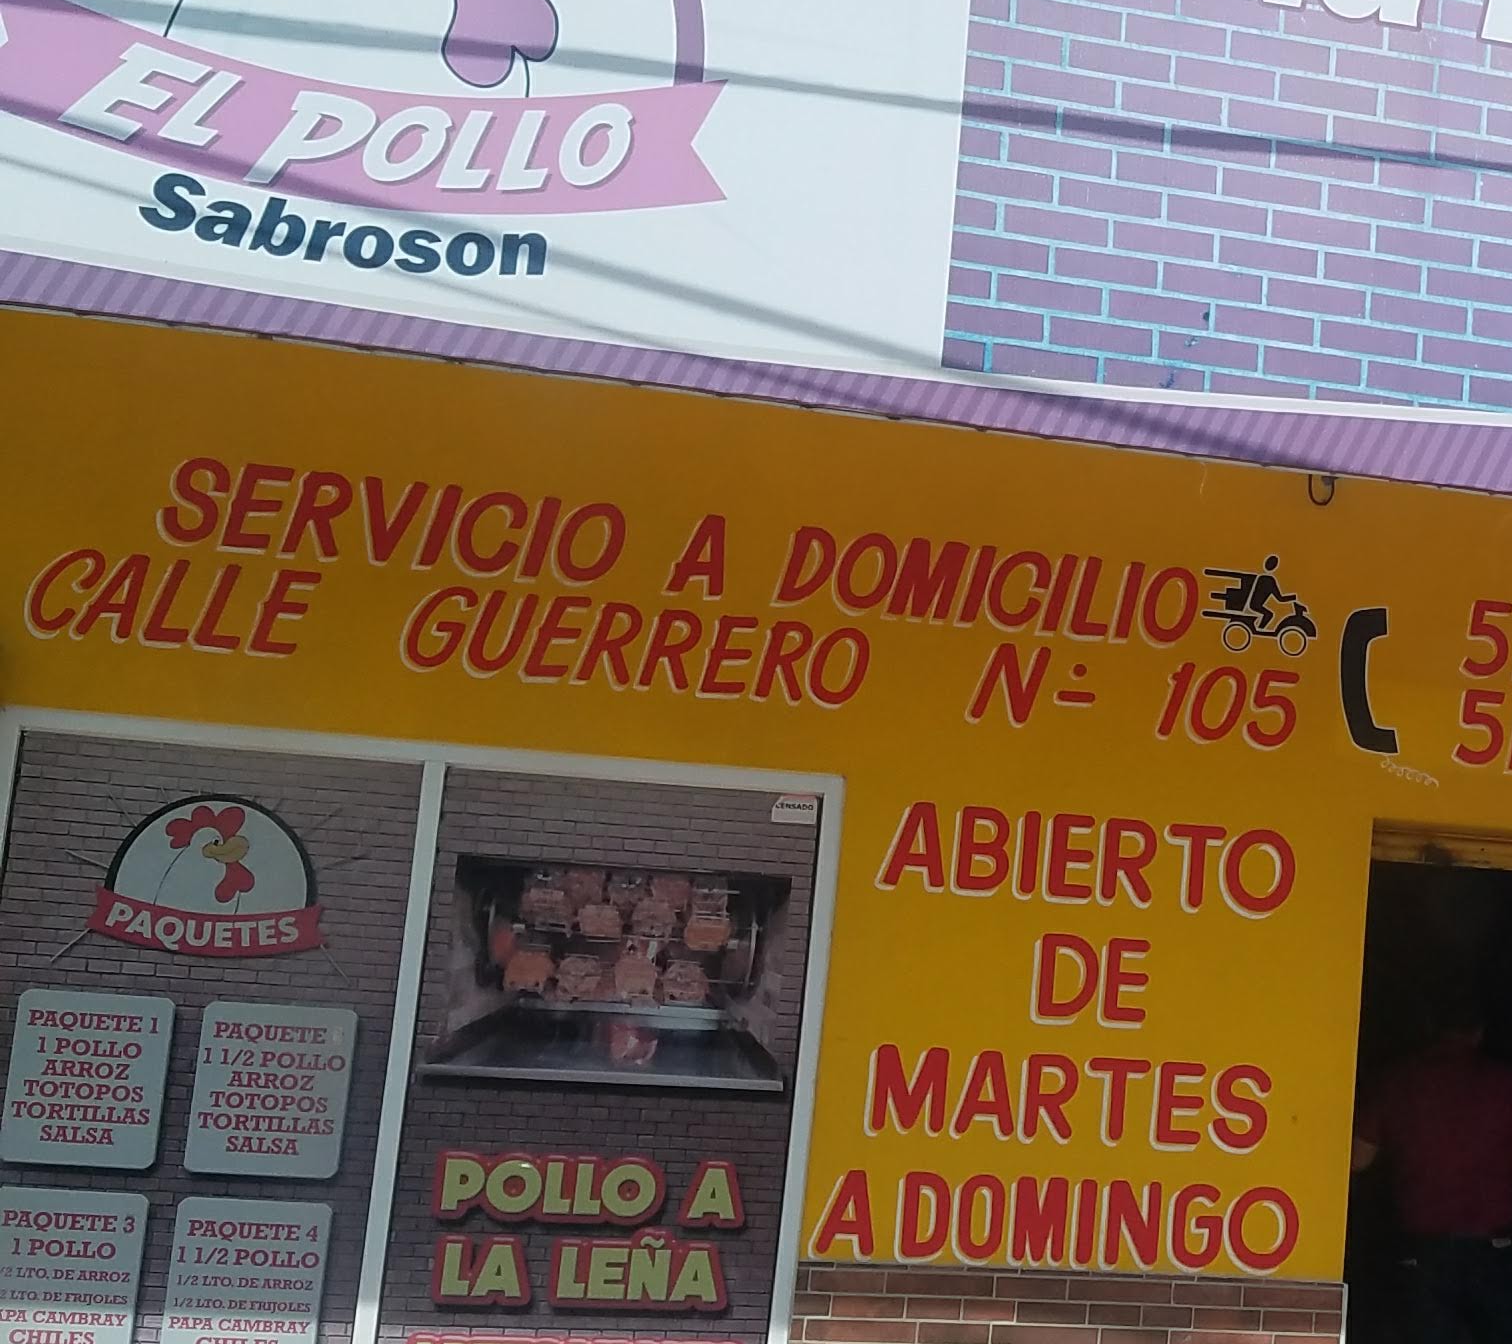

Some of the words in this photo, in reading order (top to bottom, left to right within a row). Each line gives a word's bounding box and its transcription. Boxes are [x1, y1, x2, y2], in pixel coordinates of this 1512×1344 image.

[58, 41, 247, 146] EL
[243, 81, 636, 193] POLLO
[138, 171, 550, 277] Sabroson
[156, 457, 627, 586] SERVICIO
[663, 513, 727, 602] A
[769, 524, 1199, 648] DOMICILIO
[23, 548, 323, 658] CALLE
[400, 585, 870, 710] GUERRERO
[1154, 661, 1301, 751] 105
[875, 801, 1297, 920] ABIERTO
[104, 901, 300, 951] PAQUETES
[1029, 932, 1152, 1029] DE
[27, 1009, 143, 1033] PAQUETE
[149, 1017, 159, 1034] 1
[213, 1021, 328, 1045] PAQUETE
[36, 1036, 47, 1054] 1
[54, 1037, 143, 1059] POLLO
[203, 1047, 212, 1065] 1
[220, 1048, 255, 1067] 1/2
[259, 1050, 346, 1072] POLLO
[41, 1059, 131, 1081] ARROZ
[226, 1071, 315, 1091] ARROZ
[23, 1079, 144, 1103] TOTOPOS
[209, 1091, 328, 1114] TOTOPOS
[863, 1043, 1273, 1154] MARTES
[11, 1100, 150, 1125] TORTILLAS
[197, 1112, 335, 1136] TORTILLAS
[39, 1124, 114, 1145] SALSA
[225, 1135, 299, 1155] SALSA
[440, 1157, 657, 1218] POLLO
[687, 1167, 736, 1221] A
[1, 1209, 118, 1233] PAQUETE
[122, 1215, 136, 1234] 3
[187, 1219, 301, 1242] PAQUETE
[305, 1225, 318, 1243] 4
[808, 1168, 875, 1265] A
[894, 1170, 1301, 1274] DOMINGO
[11, 1238, 21, 1255] 1
[27, 1238, 117, 1260] POLLO
[176, 1246, 186, 1263] 1
[194, 1247, 229, 1265] 1/2
[233, 1248, 320, 1269] POLLO
[16, 1267, 50, 1280] LTO.
[51, 1269, 76, 1281] DE
[77, 1270, 131, 1283] ARROZ
[440, 1241, 522, 1298] LA
[556, 1233, 718, 1303] LEÑA
[177, 1274, 199, 1286] 1/2
[202, 1275, 234, 1287] LTO.
[237, 1277, 260, 1289] DE
[262, 1278, 313, 1291] ARROZ
[42, 1291, 62, 1302] DE
[64, 1292, 128, 1305] FRIJOLES
[174, 1297, 193, 1308] 1/2
[227, 1299, 248, 1311] DE
[250, 1300, 312, 1313] FRIJOLES
[0, 1308, 27, 1323] APA
[32, 1310, 128, 1327] CAMBRAY
[168, 1316, 213, 1330] PAPA
[218, 1318, 310, 1334] CAMBRAY
